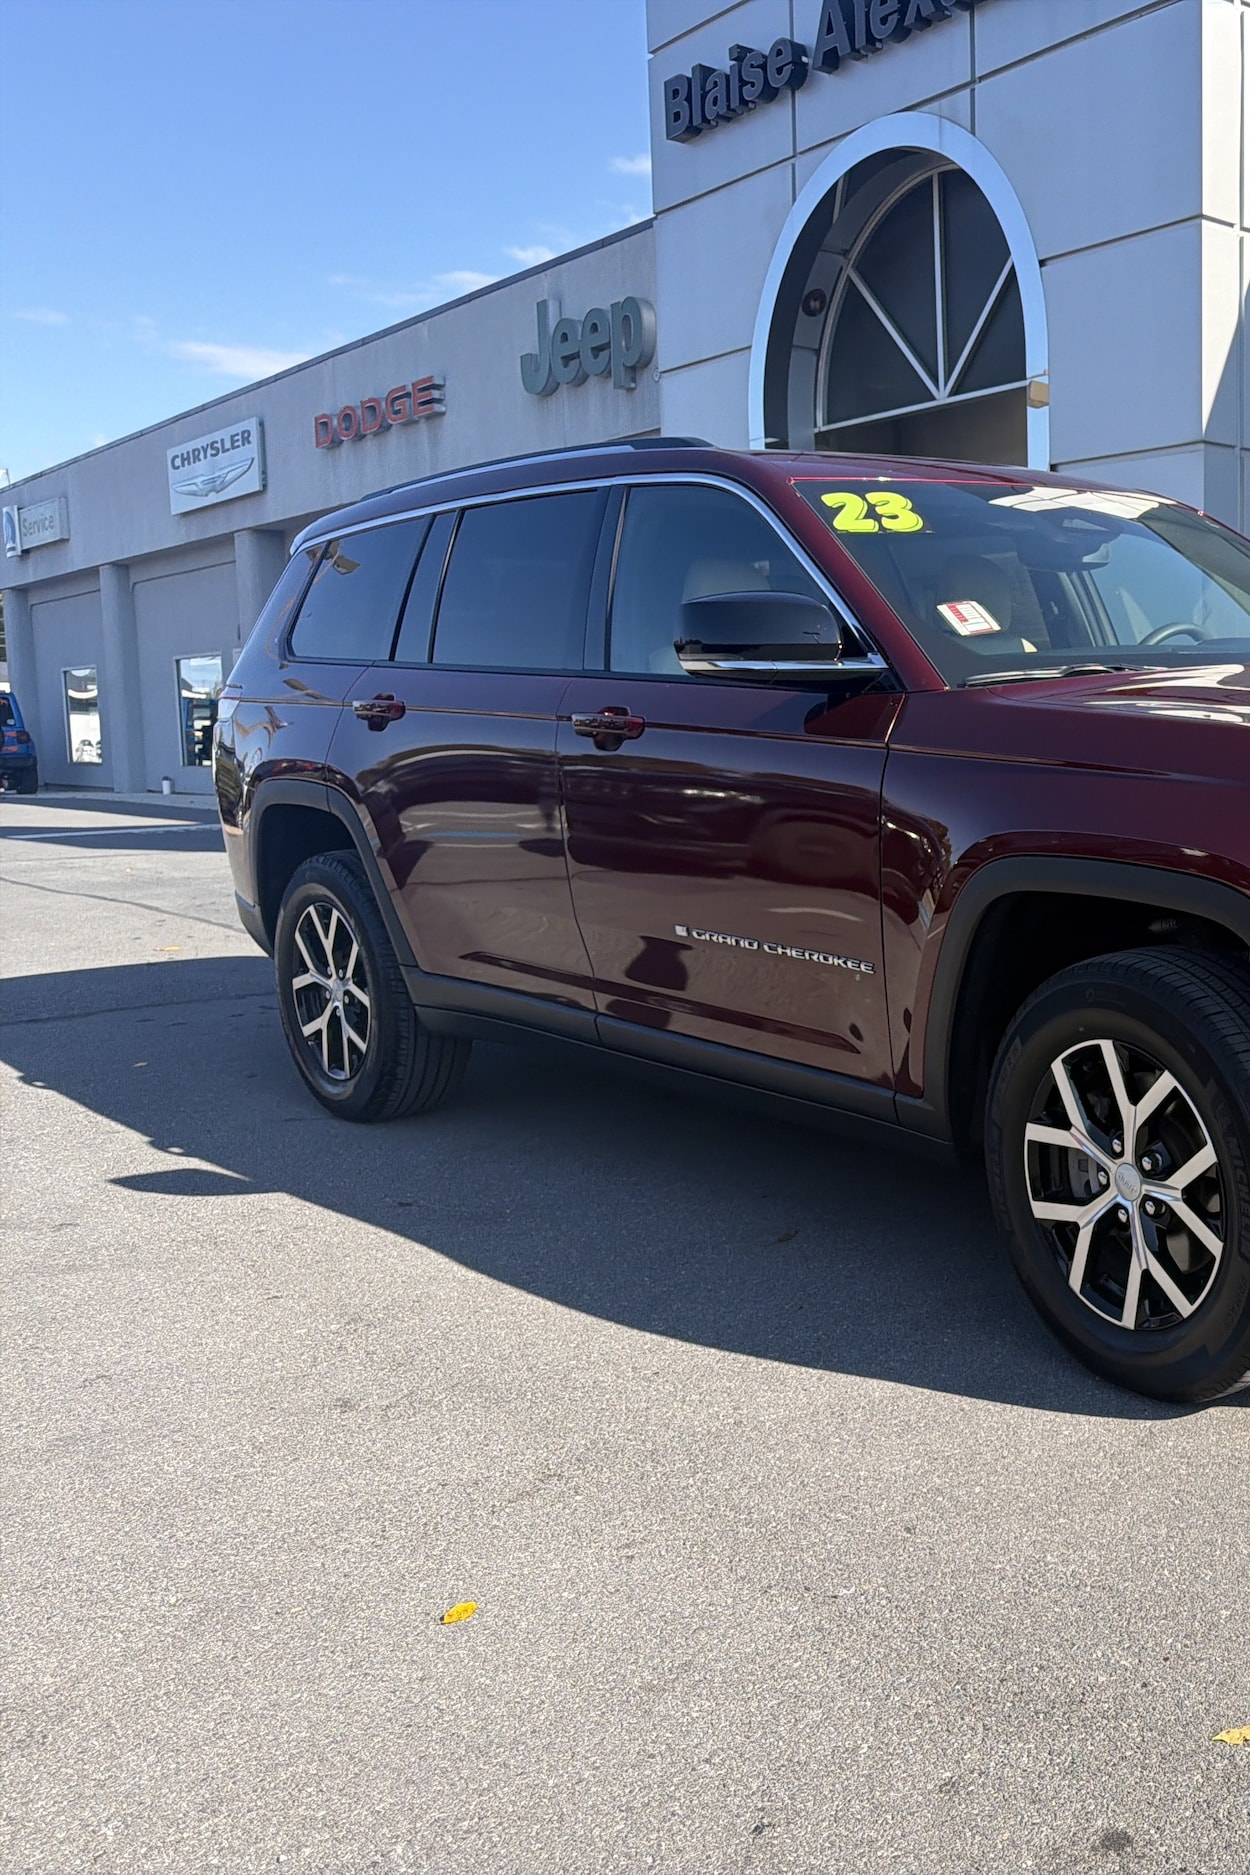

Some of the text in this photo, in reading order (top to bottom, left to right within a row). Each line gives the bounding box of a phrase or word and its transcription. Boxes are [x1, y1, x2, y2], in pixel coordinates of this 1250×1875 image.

[664, 0, 974, 142] Blaise Alex
[520, 296, 657, 396] Jeep
[315, 375, 446, 449] DODGE
[170, 429, 252, 471] CHRYSLER
[22, 512, 54, 537] Service
[820, 491, 924, 533] 23
[692, 928, 876, 975] GRAND CHEROKEE
